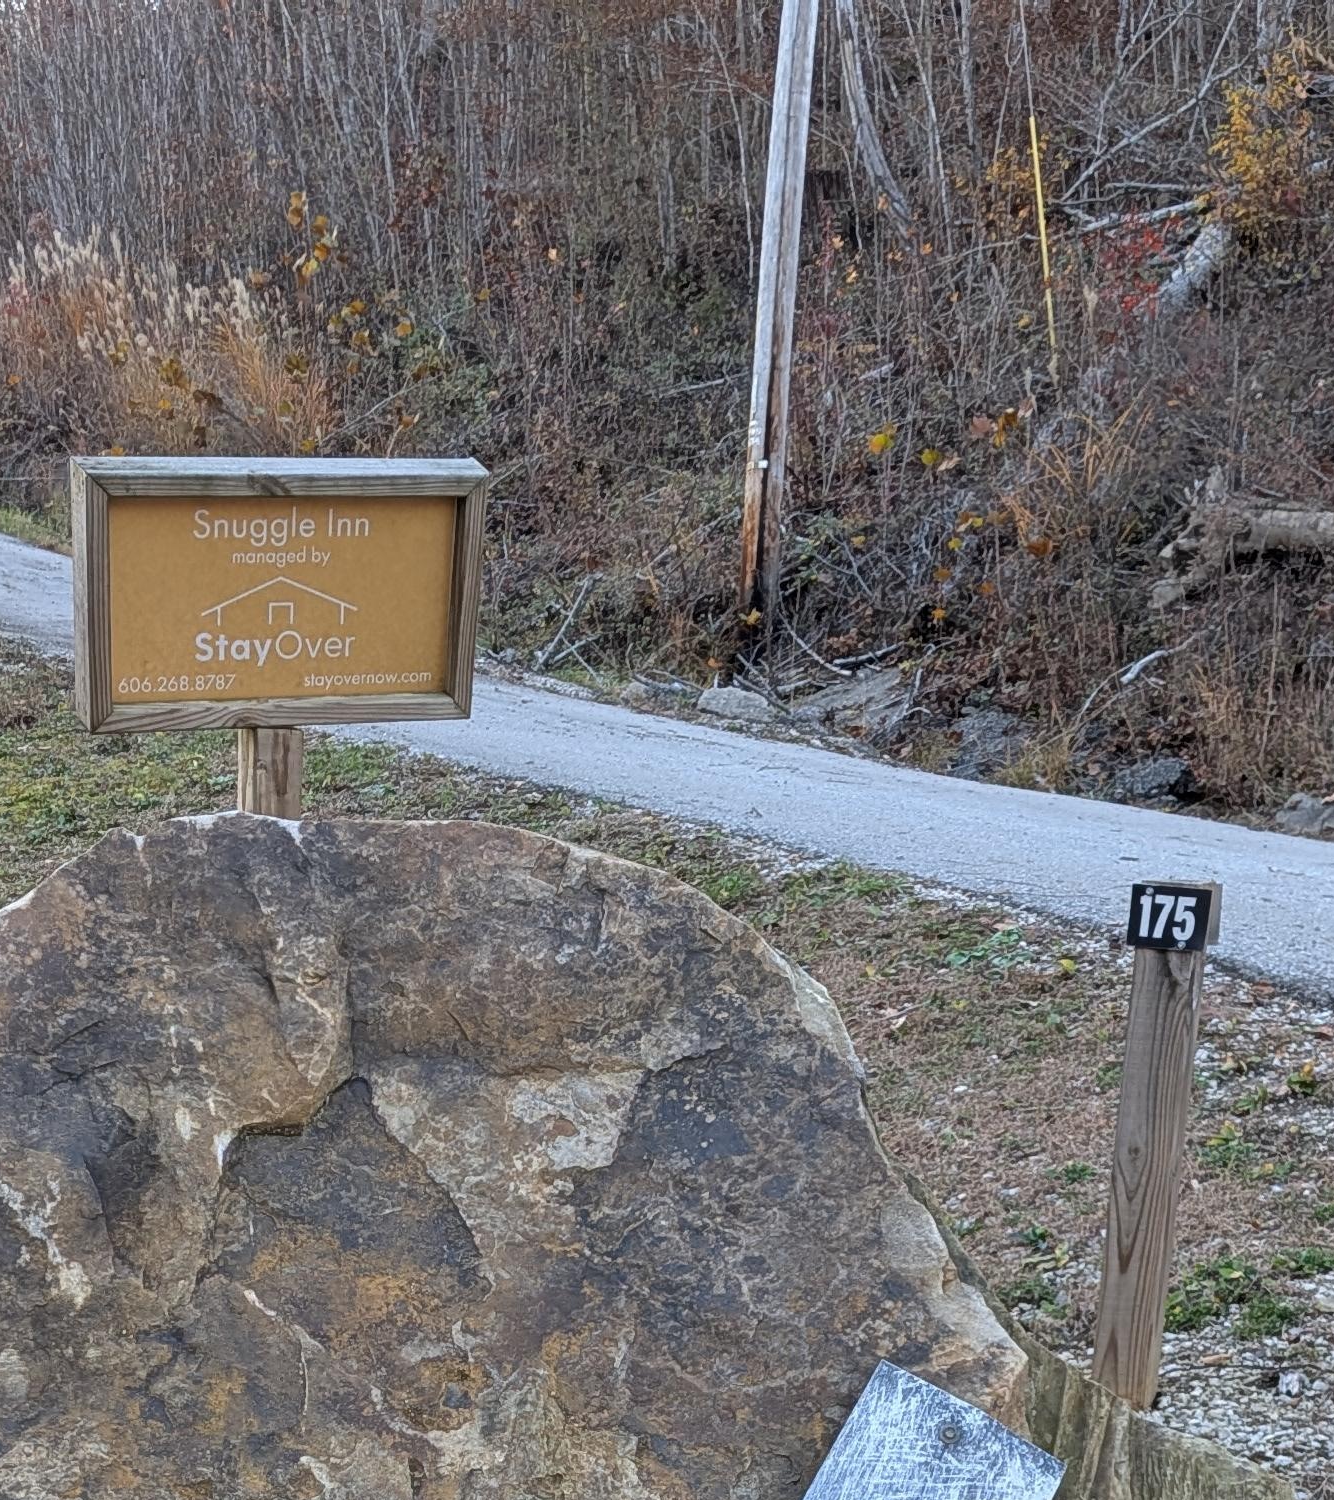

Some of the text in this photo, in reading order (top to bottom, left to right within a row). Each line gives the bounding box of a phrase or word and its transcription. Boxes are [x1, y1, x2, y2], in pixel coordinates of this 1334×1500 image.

[193, 506, 369, 547] Snuggle Inn
[232, 547, 331, 567] managed by
[194, 630, 355, 667] StayOver
[118, 674, 236, 693] 606.268.8787
[304, 670, 432, 688] stayovernow.com
[1138, 894, 1197, 941] 175
